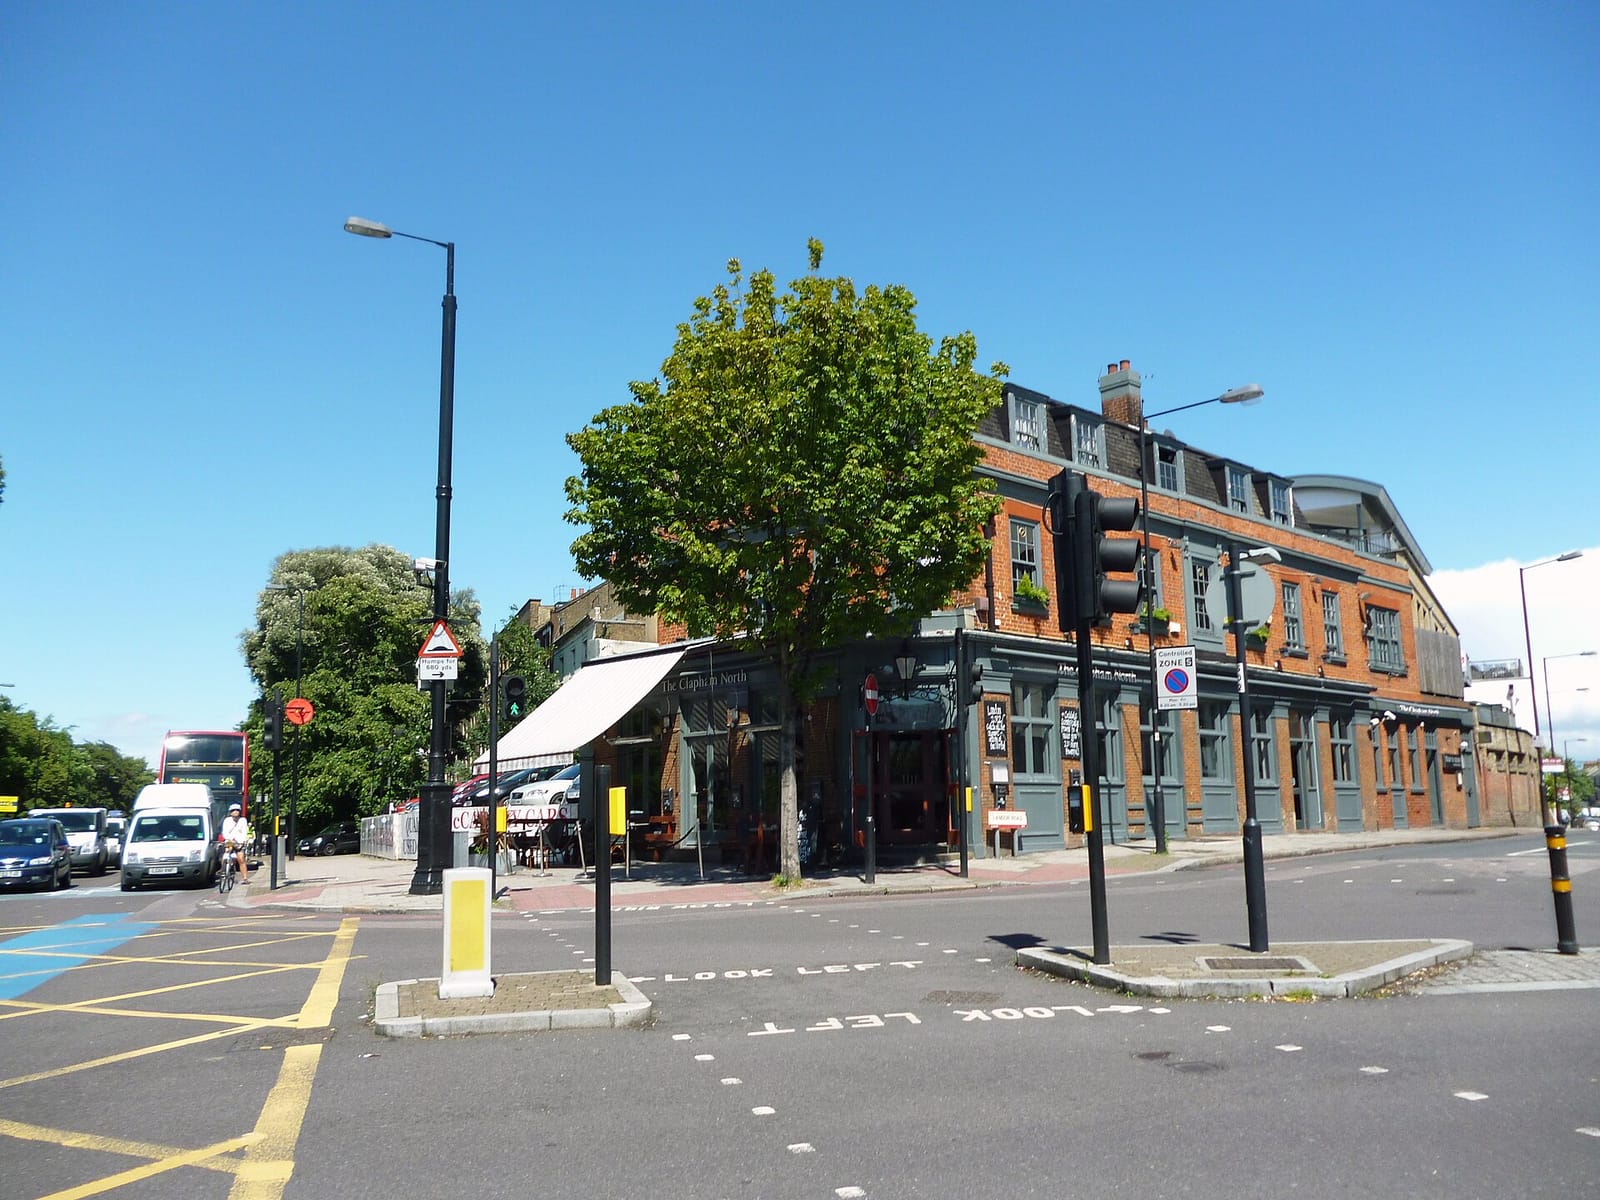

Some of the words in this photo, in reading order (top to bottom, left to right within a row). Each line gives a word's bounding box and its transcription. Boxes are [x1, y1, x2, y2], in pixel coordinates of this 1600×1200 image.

[662, 680, 676, 692] The
[679, 675, 718, 692] Clapham
[721, 669, 747, 684] North
[664, 968, 773, 982] LOOK
[797, 961, 923, 975] LEFT
[747, 1012, 922, 1036] LEFT
[953, 1006, 1094, 1022] LOOK
